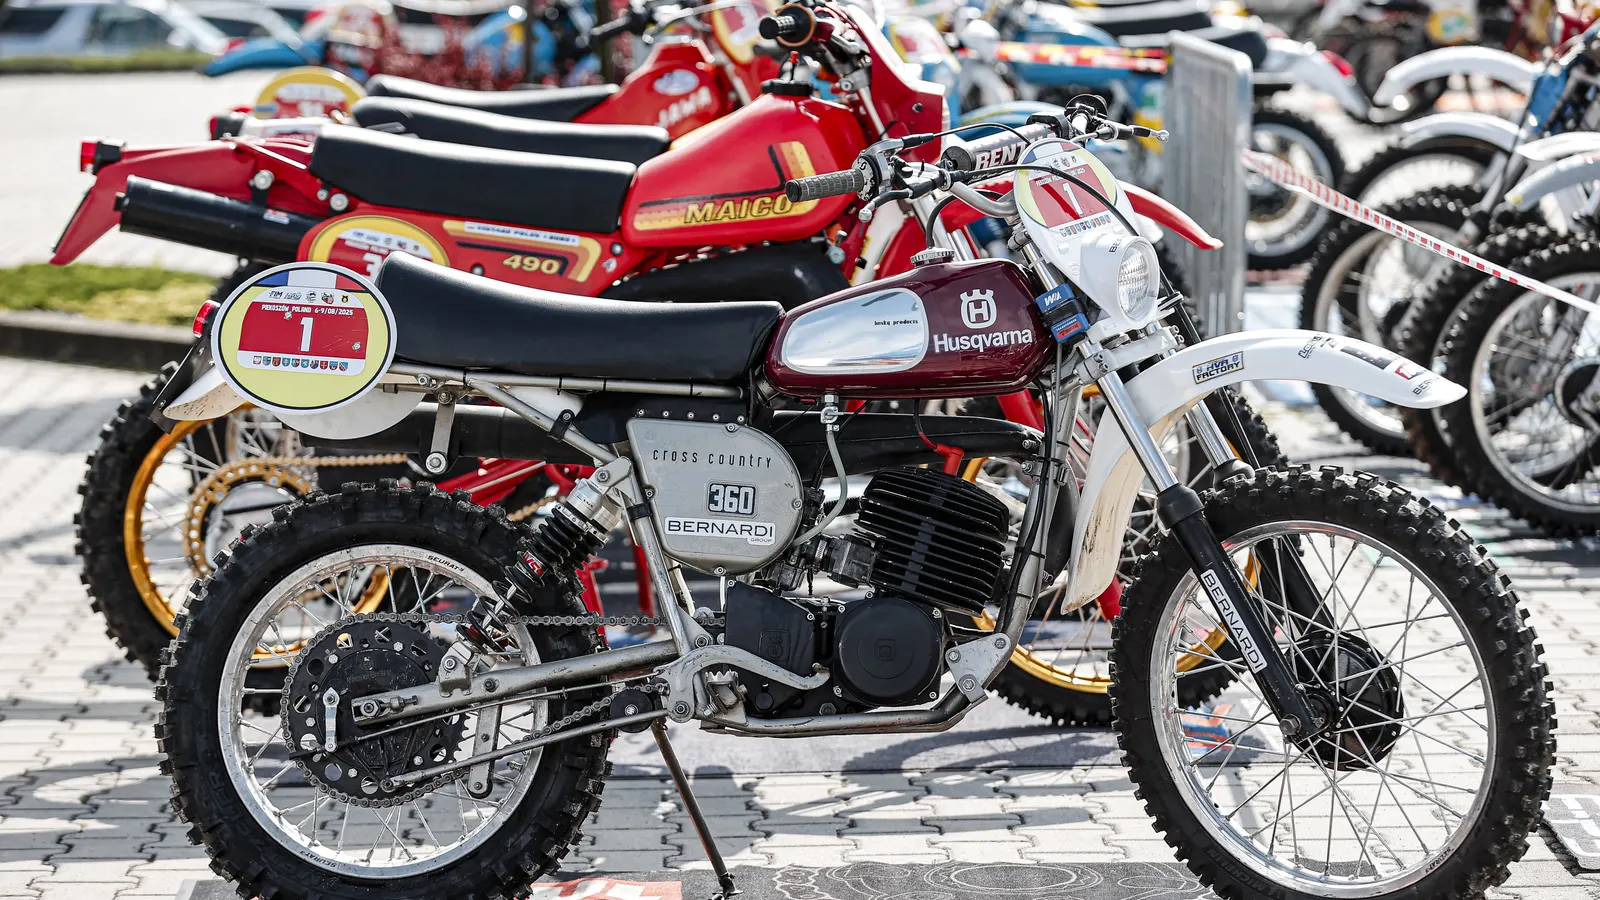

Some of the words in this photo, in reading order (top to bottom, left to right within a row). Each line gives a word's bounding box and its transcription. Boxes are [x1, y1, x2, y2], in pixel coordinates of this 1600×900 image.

[683, 194, 793, 224] MAICO
[1062, 182, 1084, 215] 1
[502, 254, 560, 275] 490
[291, 305, 312, 313] POLAND
[314, 307, 354, 316] 6-9/08/2025
[893, 318, 918, 326] products
[300, 316, 314, 353] 1
[933, 328, 1033, 352] Husqvarna
[1196, 360, 1240, 381] FACTORY
[652, 449, 698, 463] cross
[708, 452, 772, 468] country
[708, 483, 755, 515] 360
[668, 520, 773, 538] BERNARDI
[1203, 573, 1264, 669] BERNARDI
